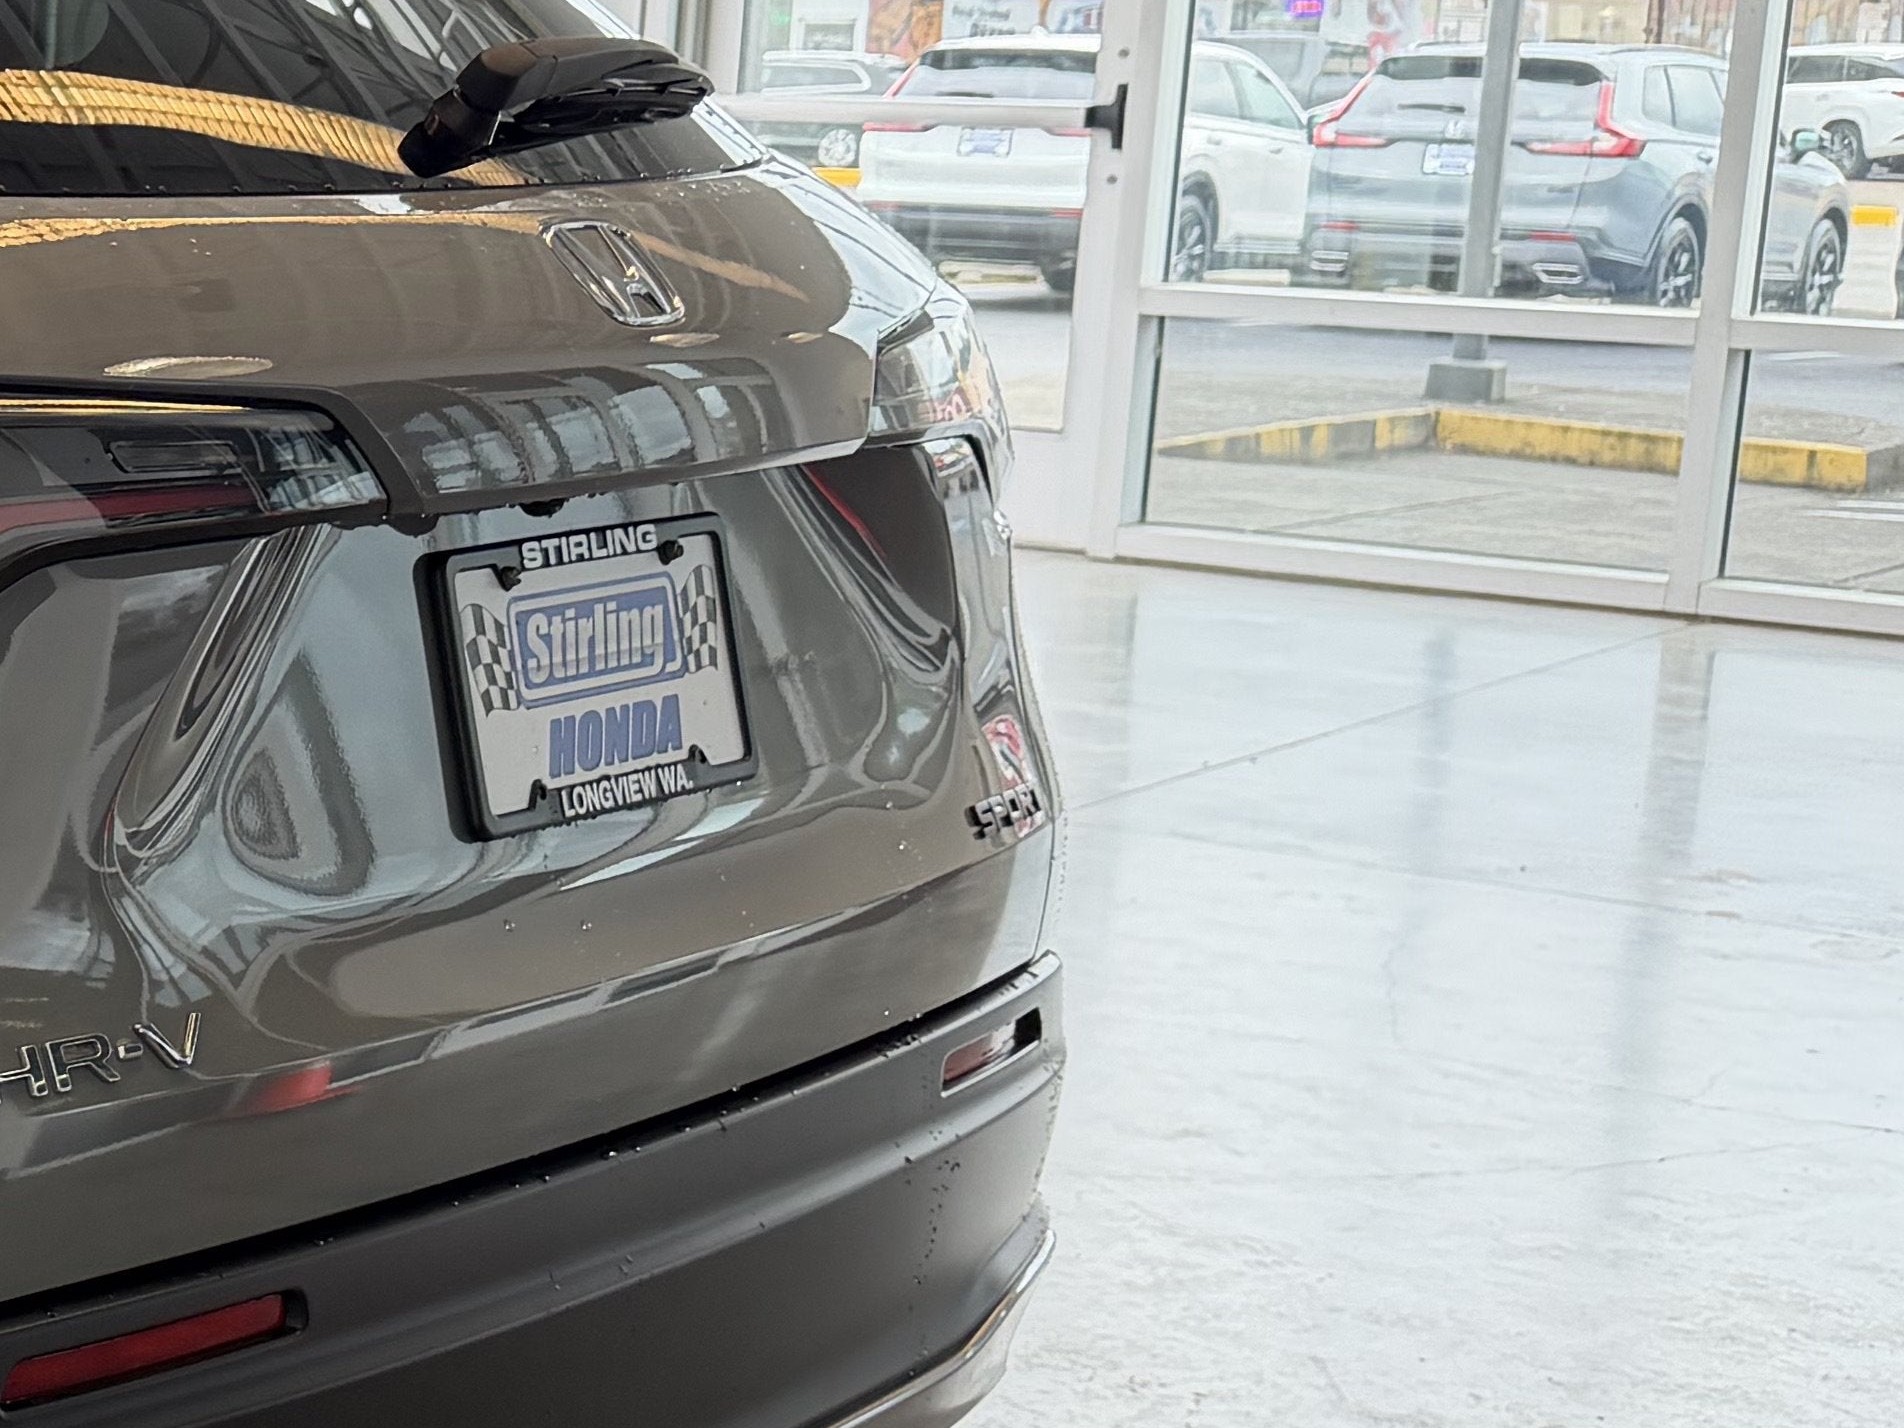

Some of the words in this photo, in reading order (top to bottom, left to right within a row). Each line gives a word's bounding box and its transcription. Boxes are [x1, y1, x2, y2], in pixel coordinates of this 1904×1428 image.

[521, 523, 659, 570] STIRLING
[526, 601, 664, 684] Stirling
[549, 693, 683, 780] HONDA
[561, 768, 655, 818] LONGVIEW
[656, 763, 694, 793] WA.
